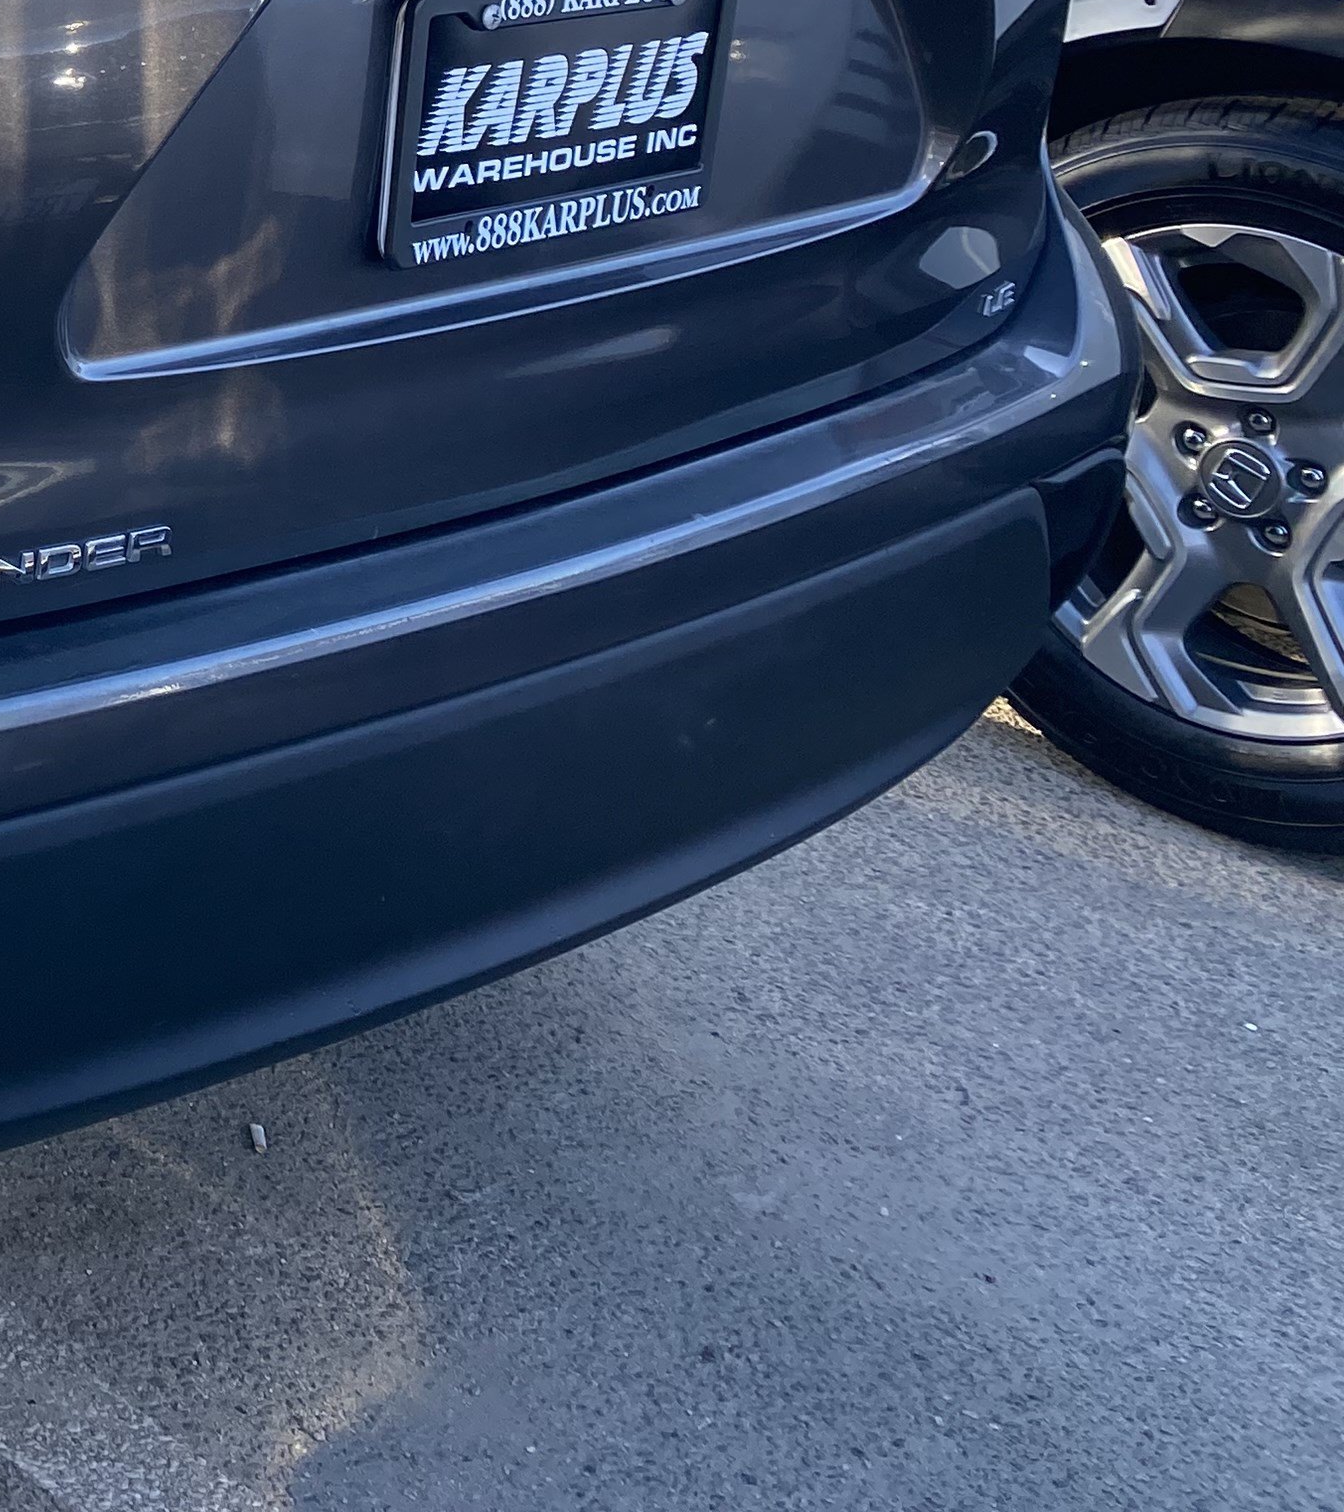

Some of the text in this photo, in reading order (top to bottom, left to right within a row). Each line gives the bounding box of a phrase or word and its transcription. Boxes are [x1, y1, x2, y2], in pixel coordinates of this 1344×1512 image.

[416, 31, 710, 157] KARPLUS
[414, 123, 699, 192] WAREHOUSE INC
